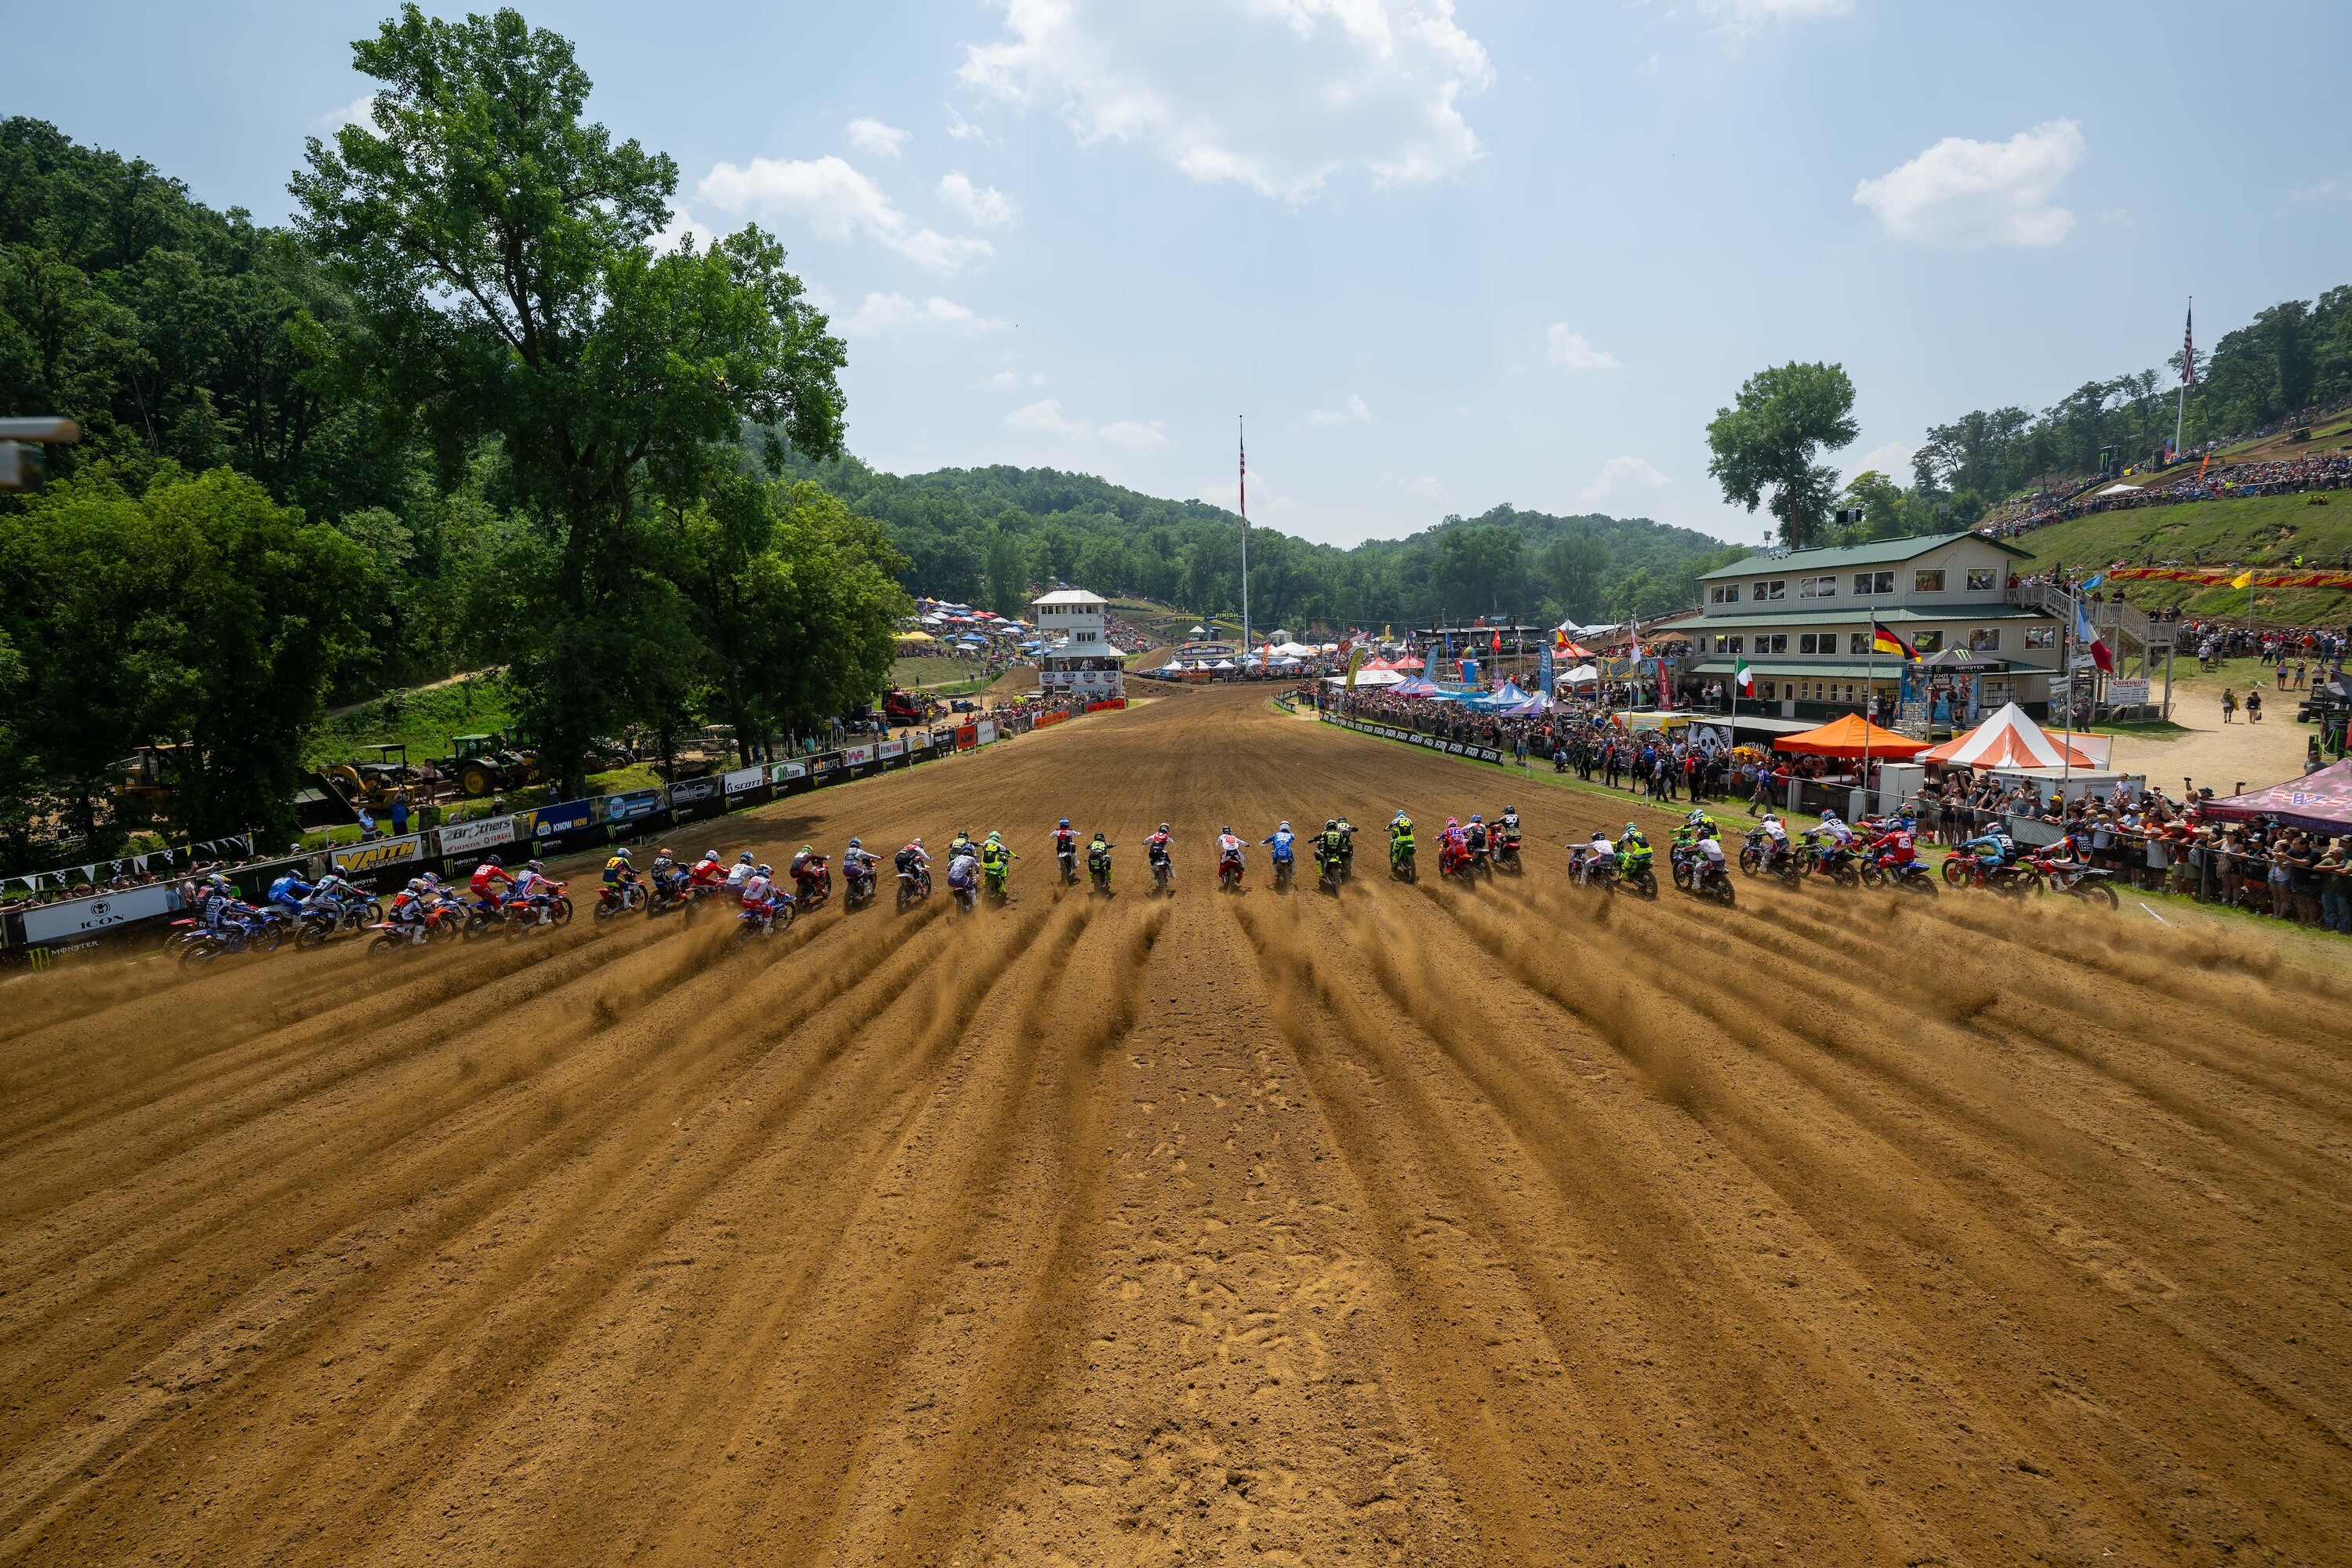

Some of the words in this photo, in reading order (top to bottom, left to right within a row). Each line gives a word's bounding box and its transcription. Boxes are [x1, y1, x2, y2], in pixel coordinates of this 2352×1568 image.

[1661, 669, 1670, 706] ATM
[1385, 728, 1396, 737] FXR
[1396, 731, 1407, 740] FXR
[1409, 734, 1423, 743] FXR
[1435, 739, 1447, 750] FXR
[1448, 742, 1464, 753] FXR
[1465, 746, 1479, 757] FXR
[1481, 749, 1497, 761] FXR
[734, 779, 760, 791] SCOTT
[539, 825, 550, 835] NAPA
[553, 821, 572, 832] KNOW
[573, 818, 587, 827] HOW
[491, 832, 512, 842] YAMAHA
[1327, 835, 1340, 845] 83
[454, 841, 481, 851] HONDA
[1898, 837, 1911, 849] 451
[336, 840, 417, 871] VAITH
[454, 857, 478, 866] MONSTER
[608, 859, 621, 868] 37
[348, 877, 377, 887] MONSTER
[81, 914, 124, 929] ICON
[51, 941, 98, 956] MONSTER
